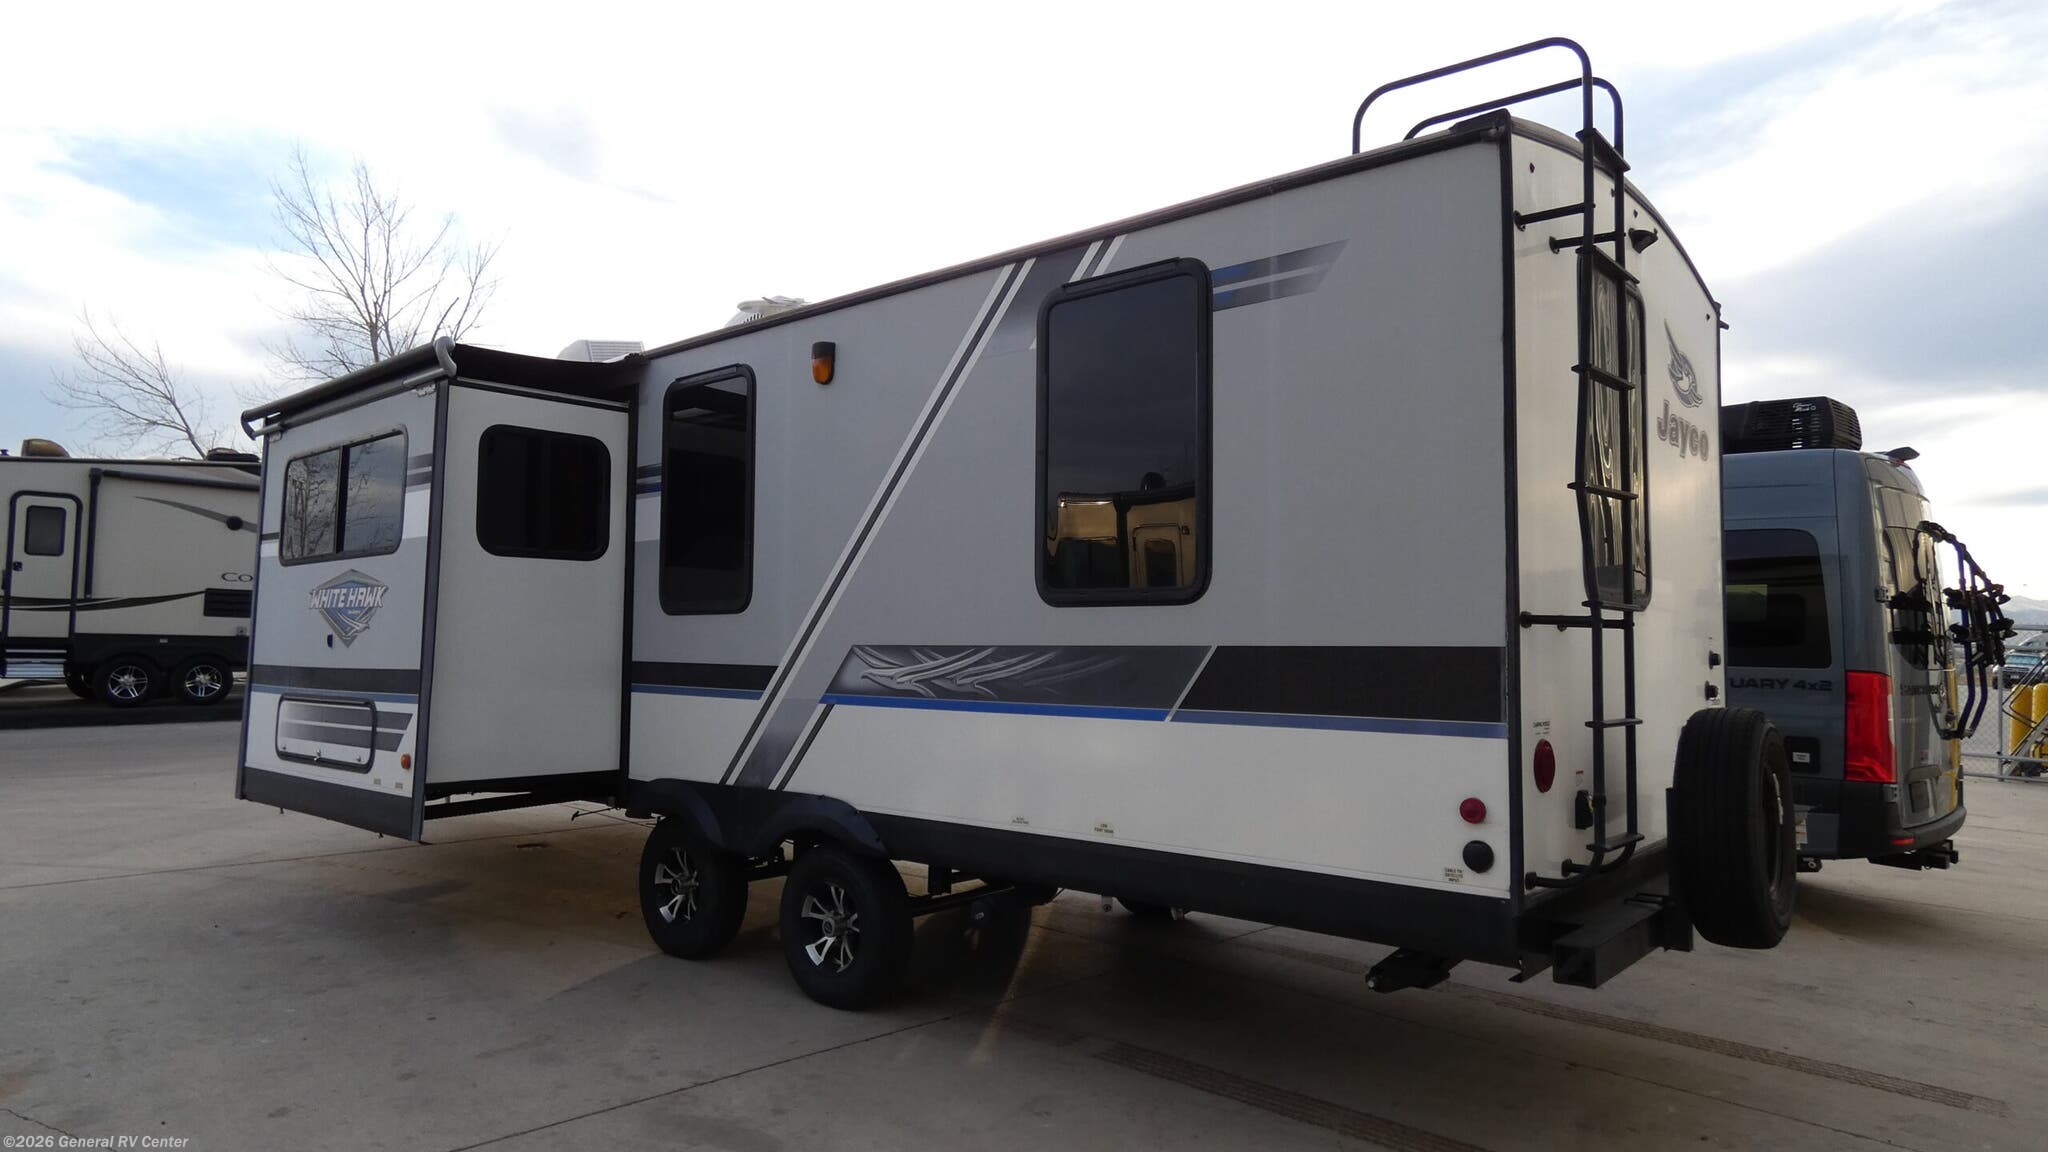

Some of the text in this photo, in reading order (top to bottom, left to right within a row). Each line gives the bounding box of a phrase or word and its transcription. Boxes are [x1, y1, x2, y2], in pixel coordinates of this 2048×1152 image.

[1656, 399, 1709, 462] Jayco
[310, 585, 387, 609] WHITE HAWK
